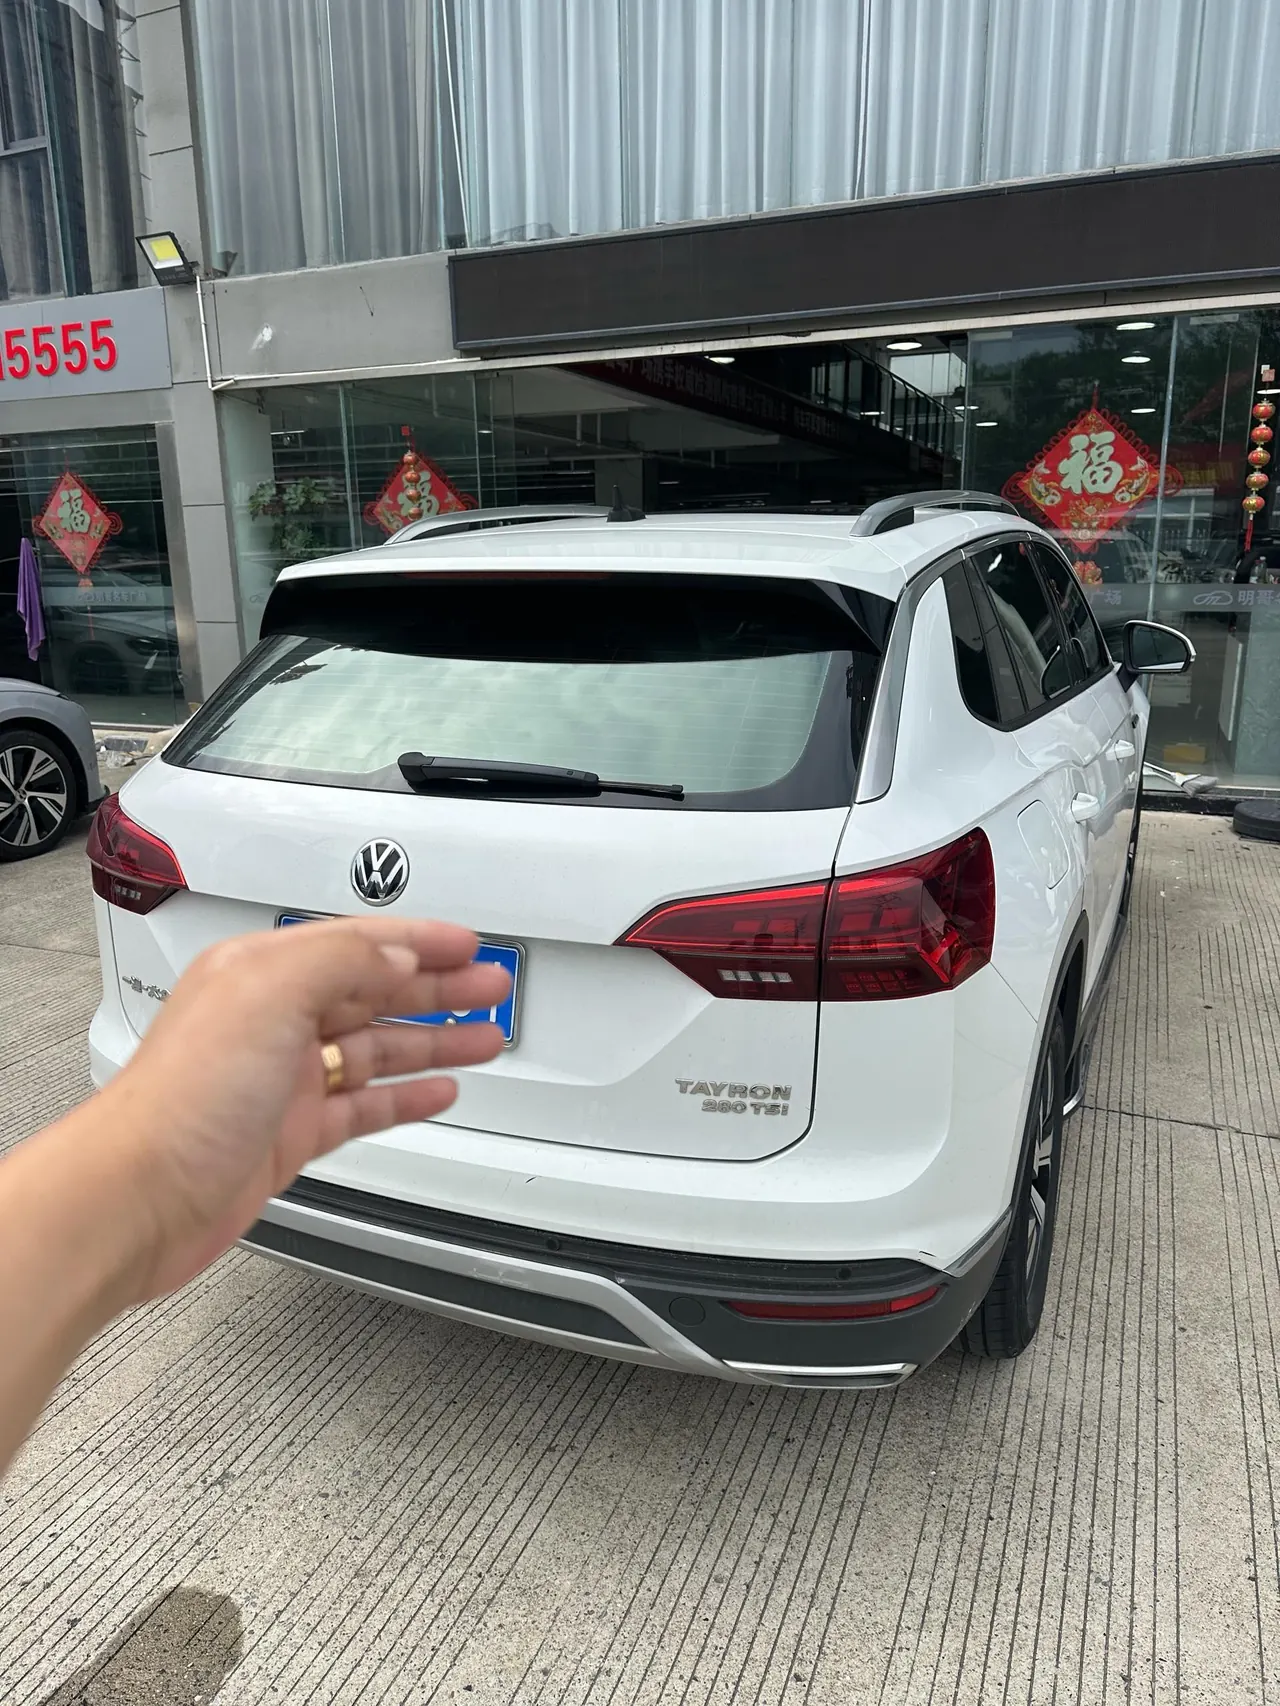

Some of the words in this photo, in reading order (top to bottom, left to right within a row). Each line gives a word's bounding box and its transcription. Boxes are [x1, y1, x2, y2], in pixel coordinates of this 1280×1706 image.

[0, 317, 118, 380] 5555
[1058, 431, 1124, 494] 福
[57, 488, 91, 533] 福
[674, 1077, 792, 1101] TAYRON
[701, 1098, 748, 1114] 280
